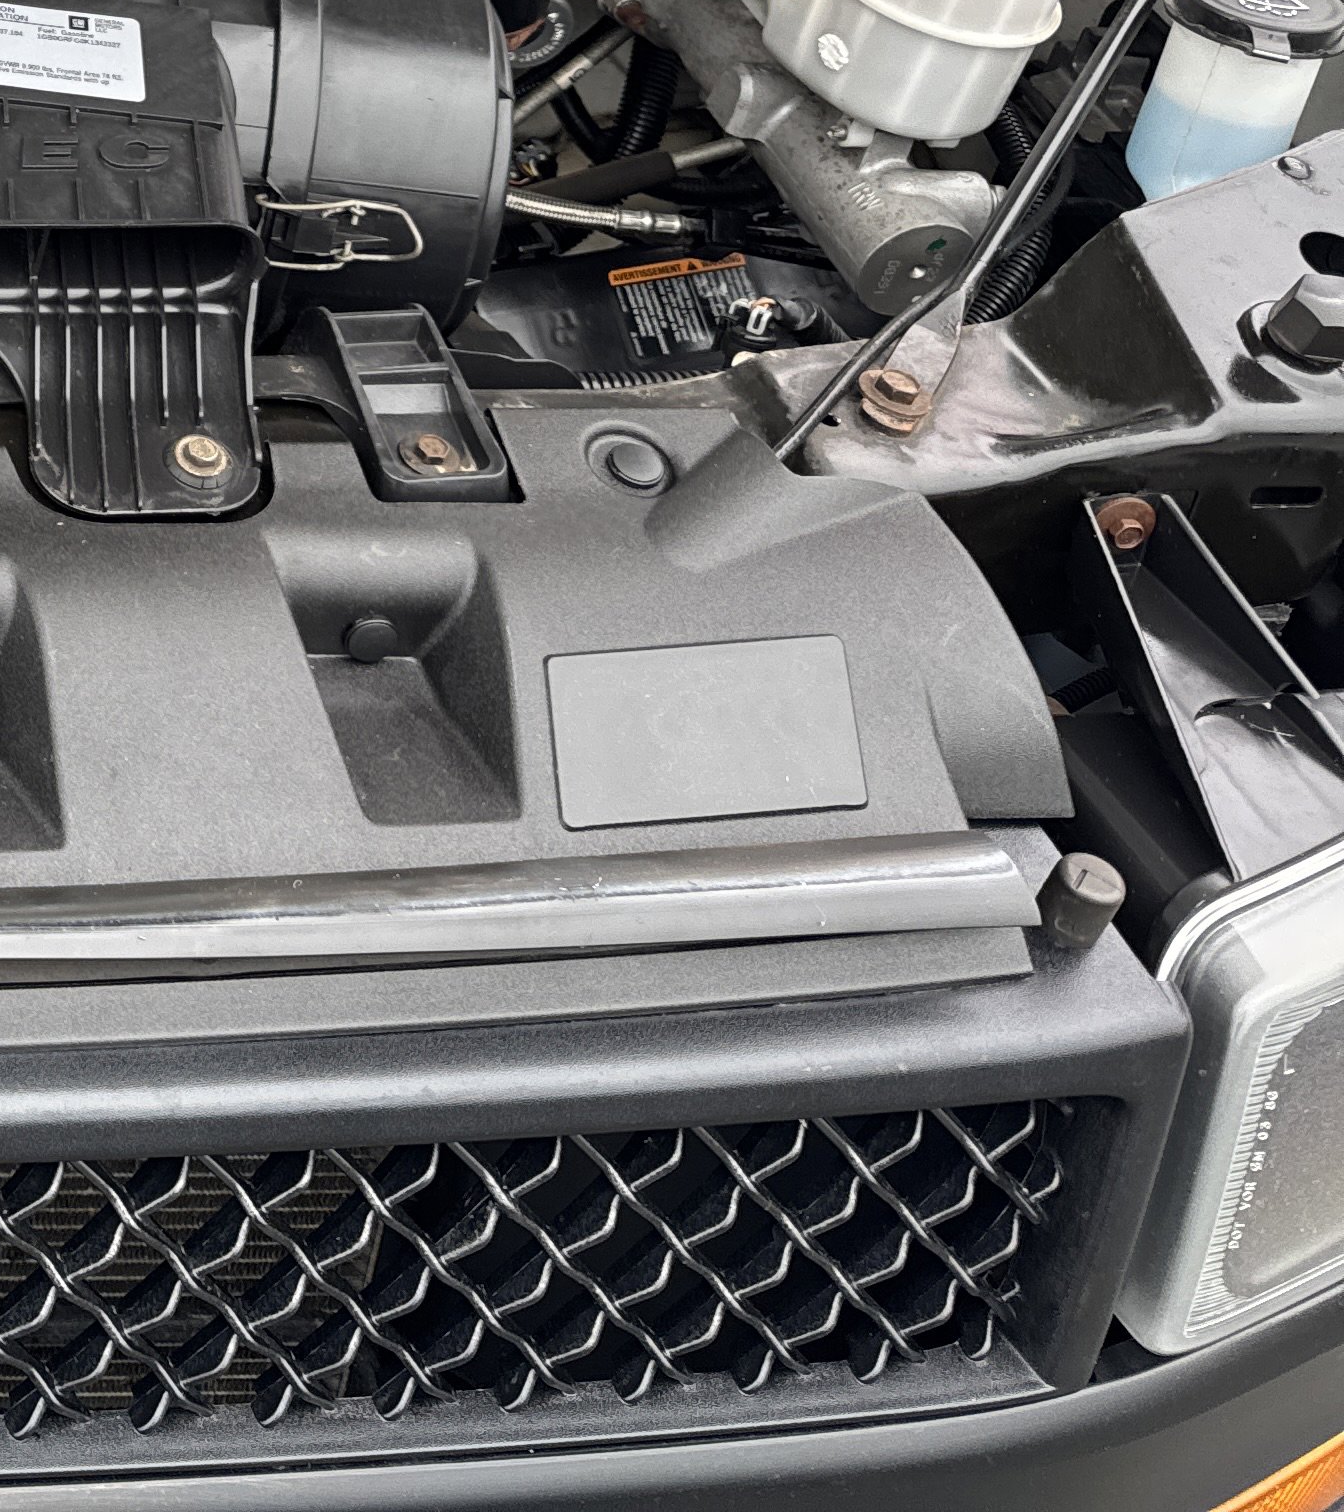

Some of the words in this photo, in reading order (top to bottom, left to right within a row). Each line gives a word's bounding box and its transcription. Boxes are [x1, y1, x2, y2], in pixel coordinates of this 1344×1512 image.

[613, 263, 682, 282] AVERTISSEMENT
[1228, 1222, 1246, 1250] DOT
[1239, 1182, 1257, 1211] VOR
